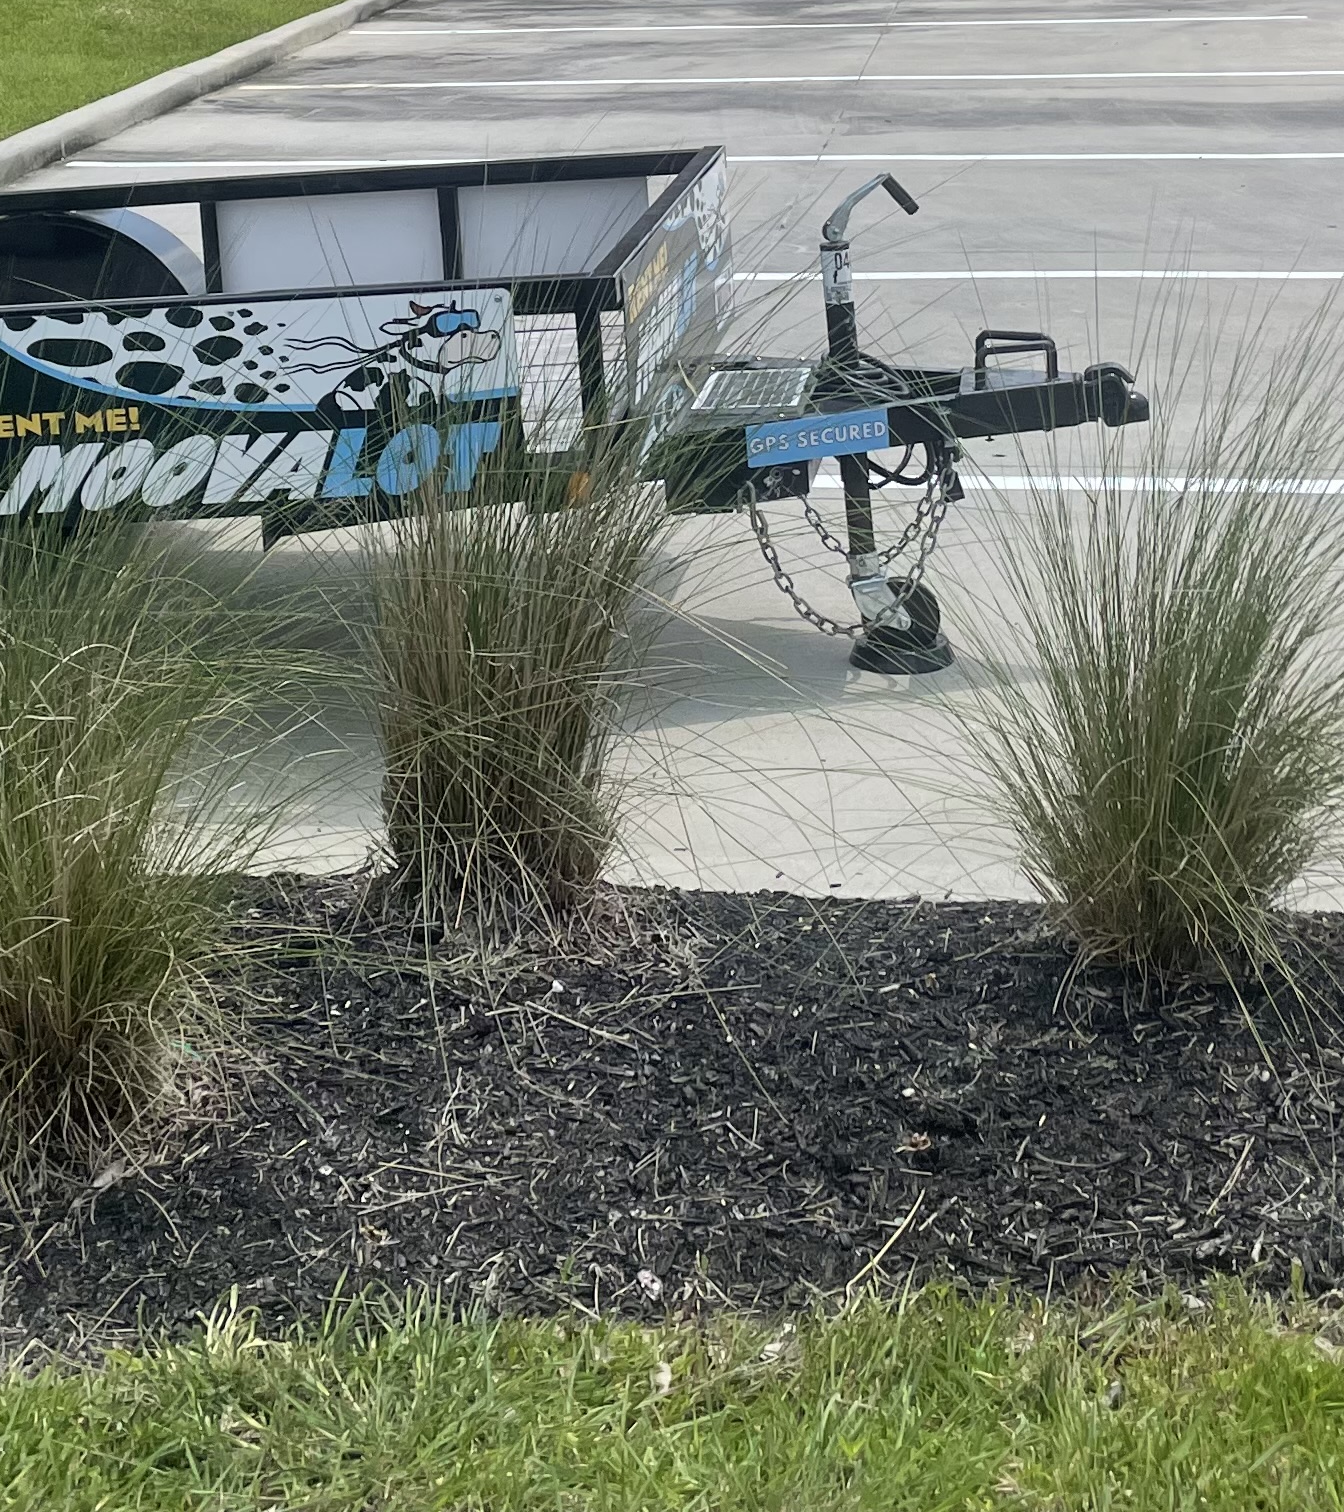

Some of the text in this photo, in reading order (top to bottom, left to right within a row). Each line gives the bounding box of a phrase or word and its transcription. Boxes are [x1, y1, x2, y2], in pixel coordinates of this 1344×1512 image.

[74, 407, 141, 433] ME!
[749, 421, 886, 454] GPS SECURED
